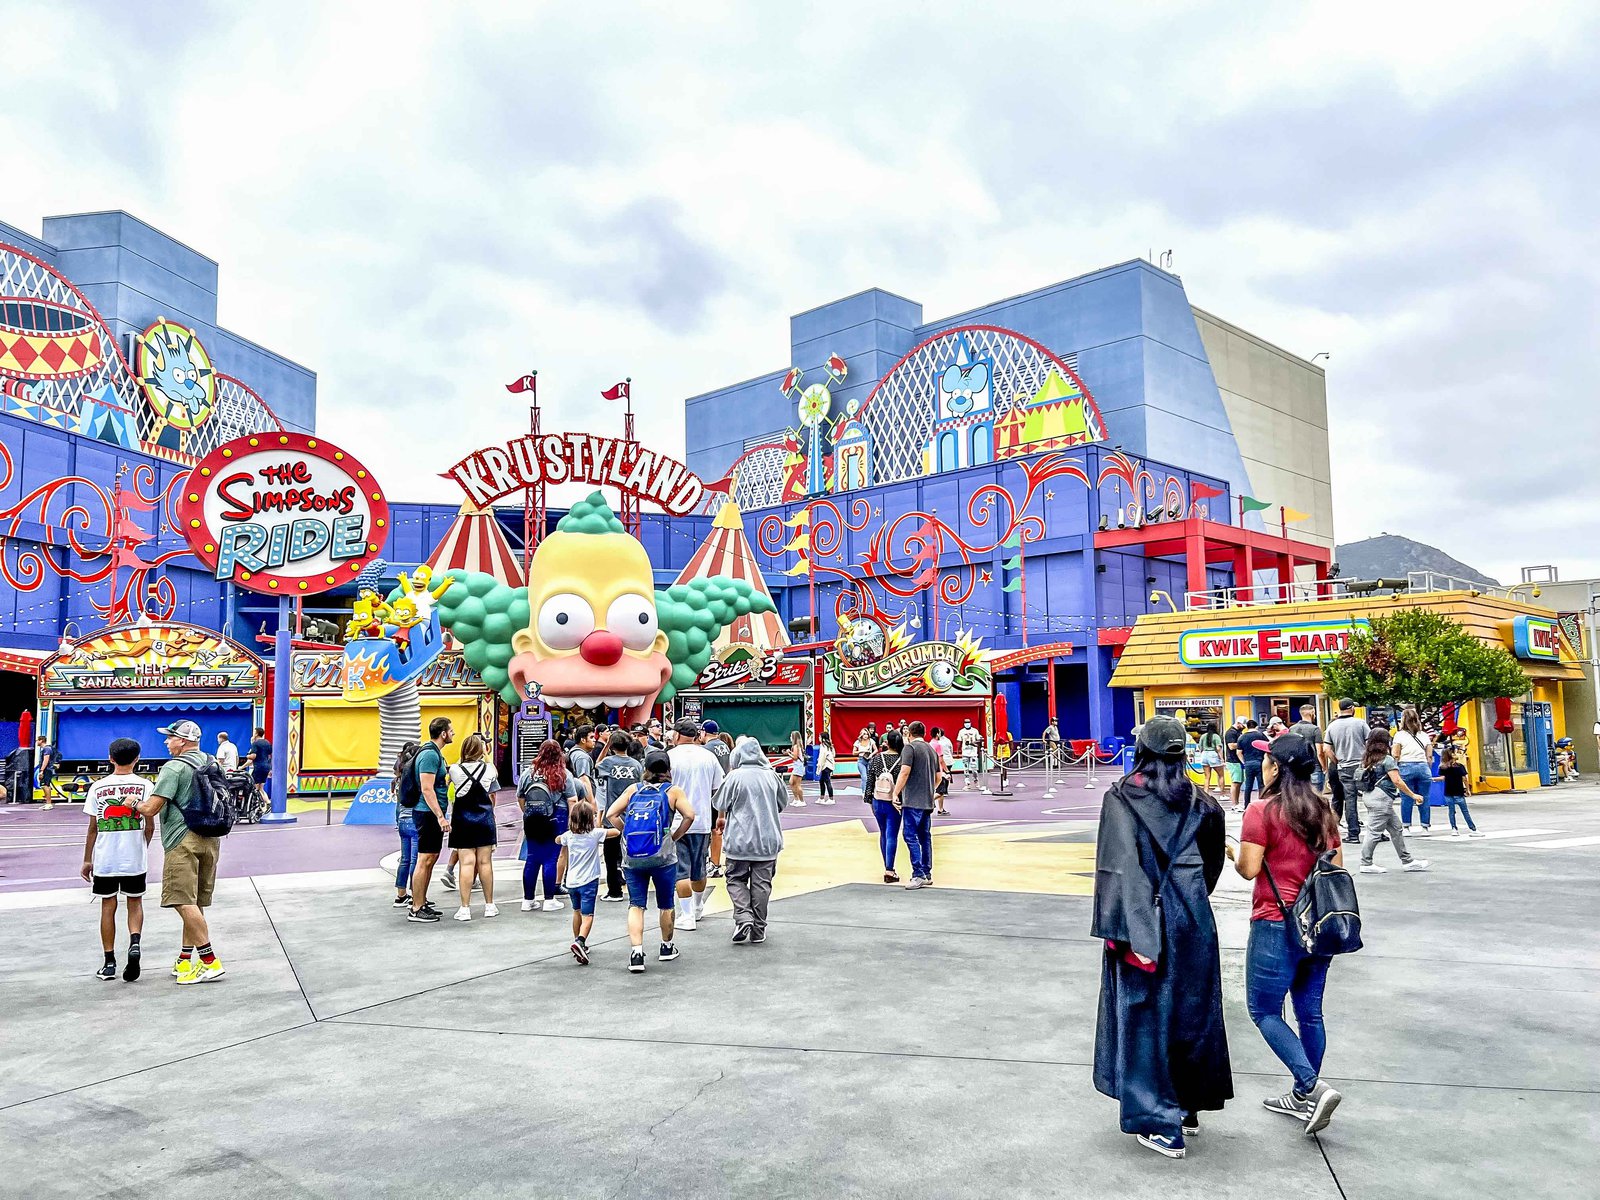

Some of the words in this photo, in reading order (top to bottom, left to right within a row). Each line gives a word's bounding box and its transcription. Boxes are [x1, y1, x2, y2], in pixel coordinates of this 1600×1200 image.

[523, 376, 532, 390] K
[617, 384, 627, 397] K
[452, 433, 703, 516] KRUSTYLAND
[217, 472, 356, 521] SIMPSONS
[215, 514, 368, 582] RIDE
[1198, 629, 1350, 661] KWIK-E-MART
[134, 663, 169, 676] HELP
[347, 666, 366, 691] K
[699, 660, 750, 685] Strike
[760, 656, 777, 679] 3
[842, 668, 879, 689] EYE
[877, 643, 961, 682] CARUMBA!
[133, 676, 175, 688] LITTLE
[175, 675, 225, 688] HELPER
[96, 787, 117, 799] NEW
[118, 786, 143, 796] YORK
